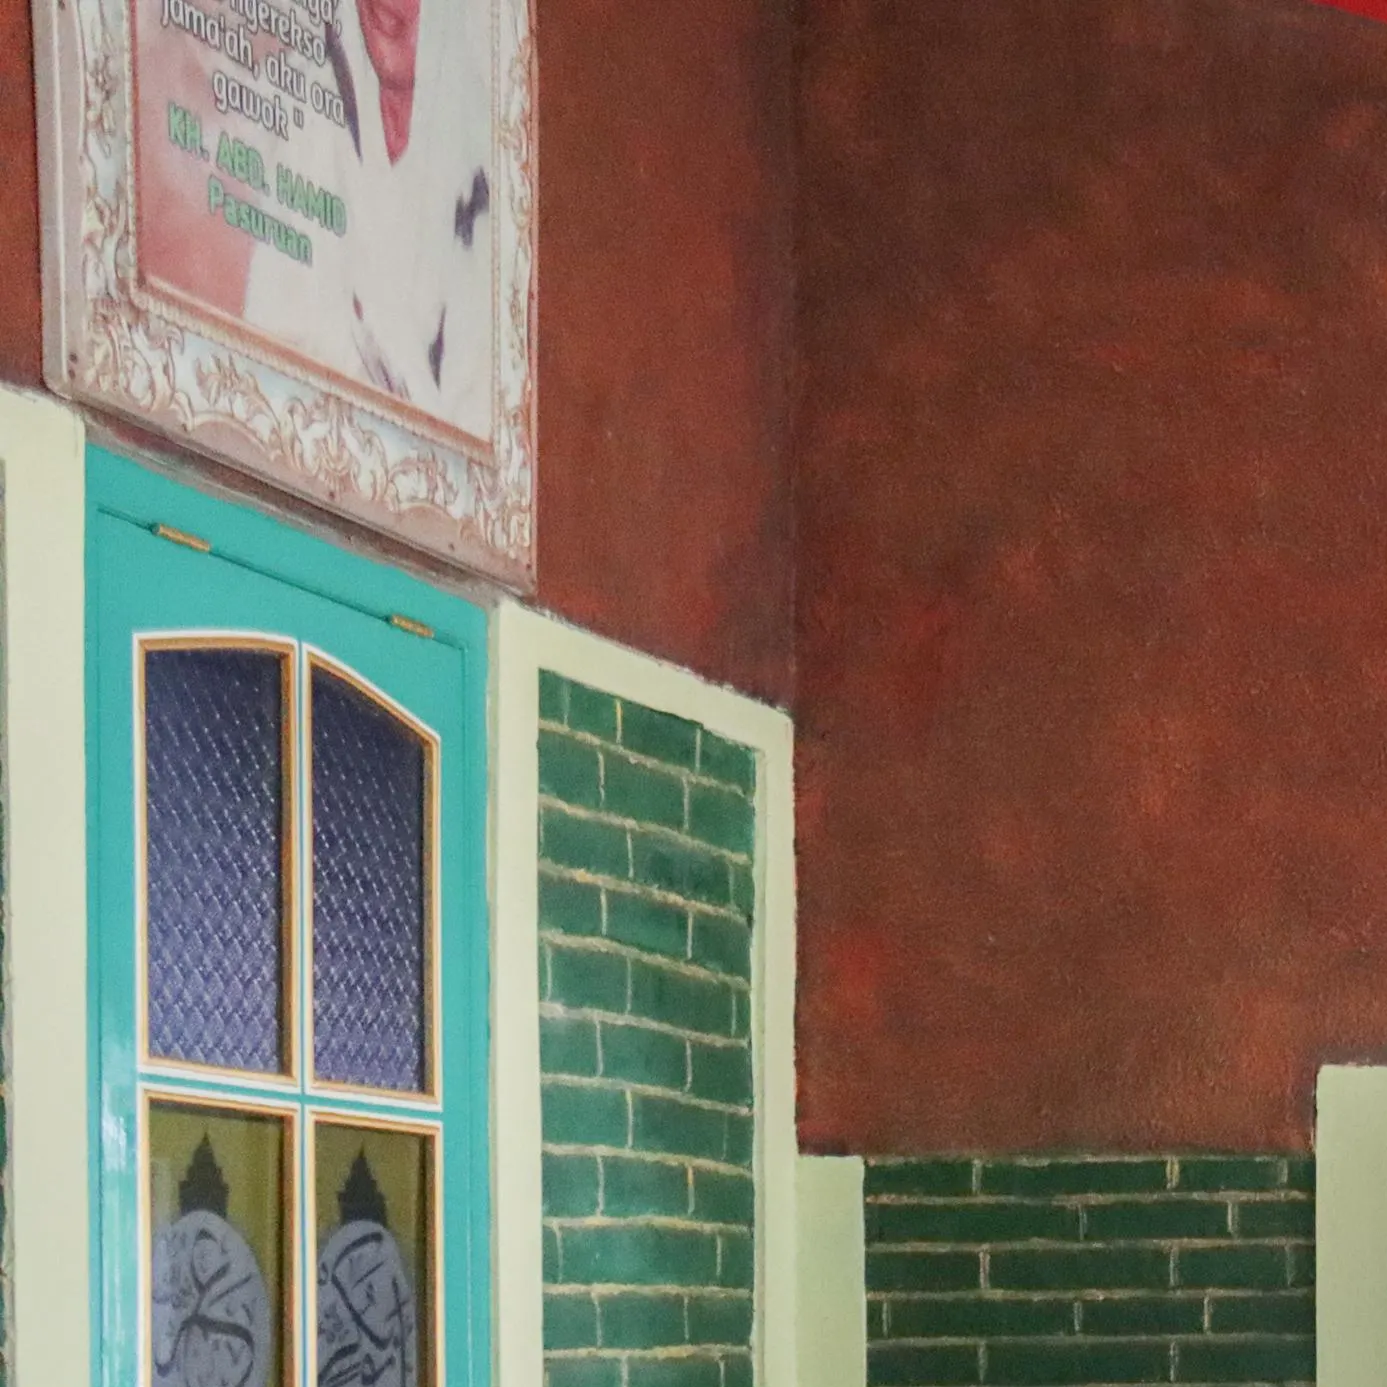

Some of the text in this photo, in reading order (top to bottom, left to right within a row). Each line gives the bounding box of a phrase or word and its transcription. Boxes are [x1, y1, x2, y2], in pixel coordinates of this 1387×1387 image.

[212, 71, 289, 141] gawok
[266, 53, 306, 104] aku
[311, 82, 346, 127] ora
[168, 101, 347, 238] KH. ABD. HAMID
[208, 174, 312, 267] Pasuruan
